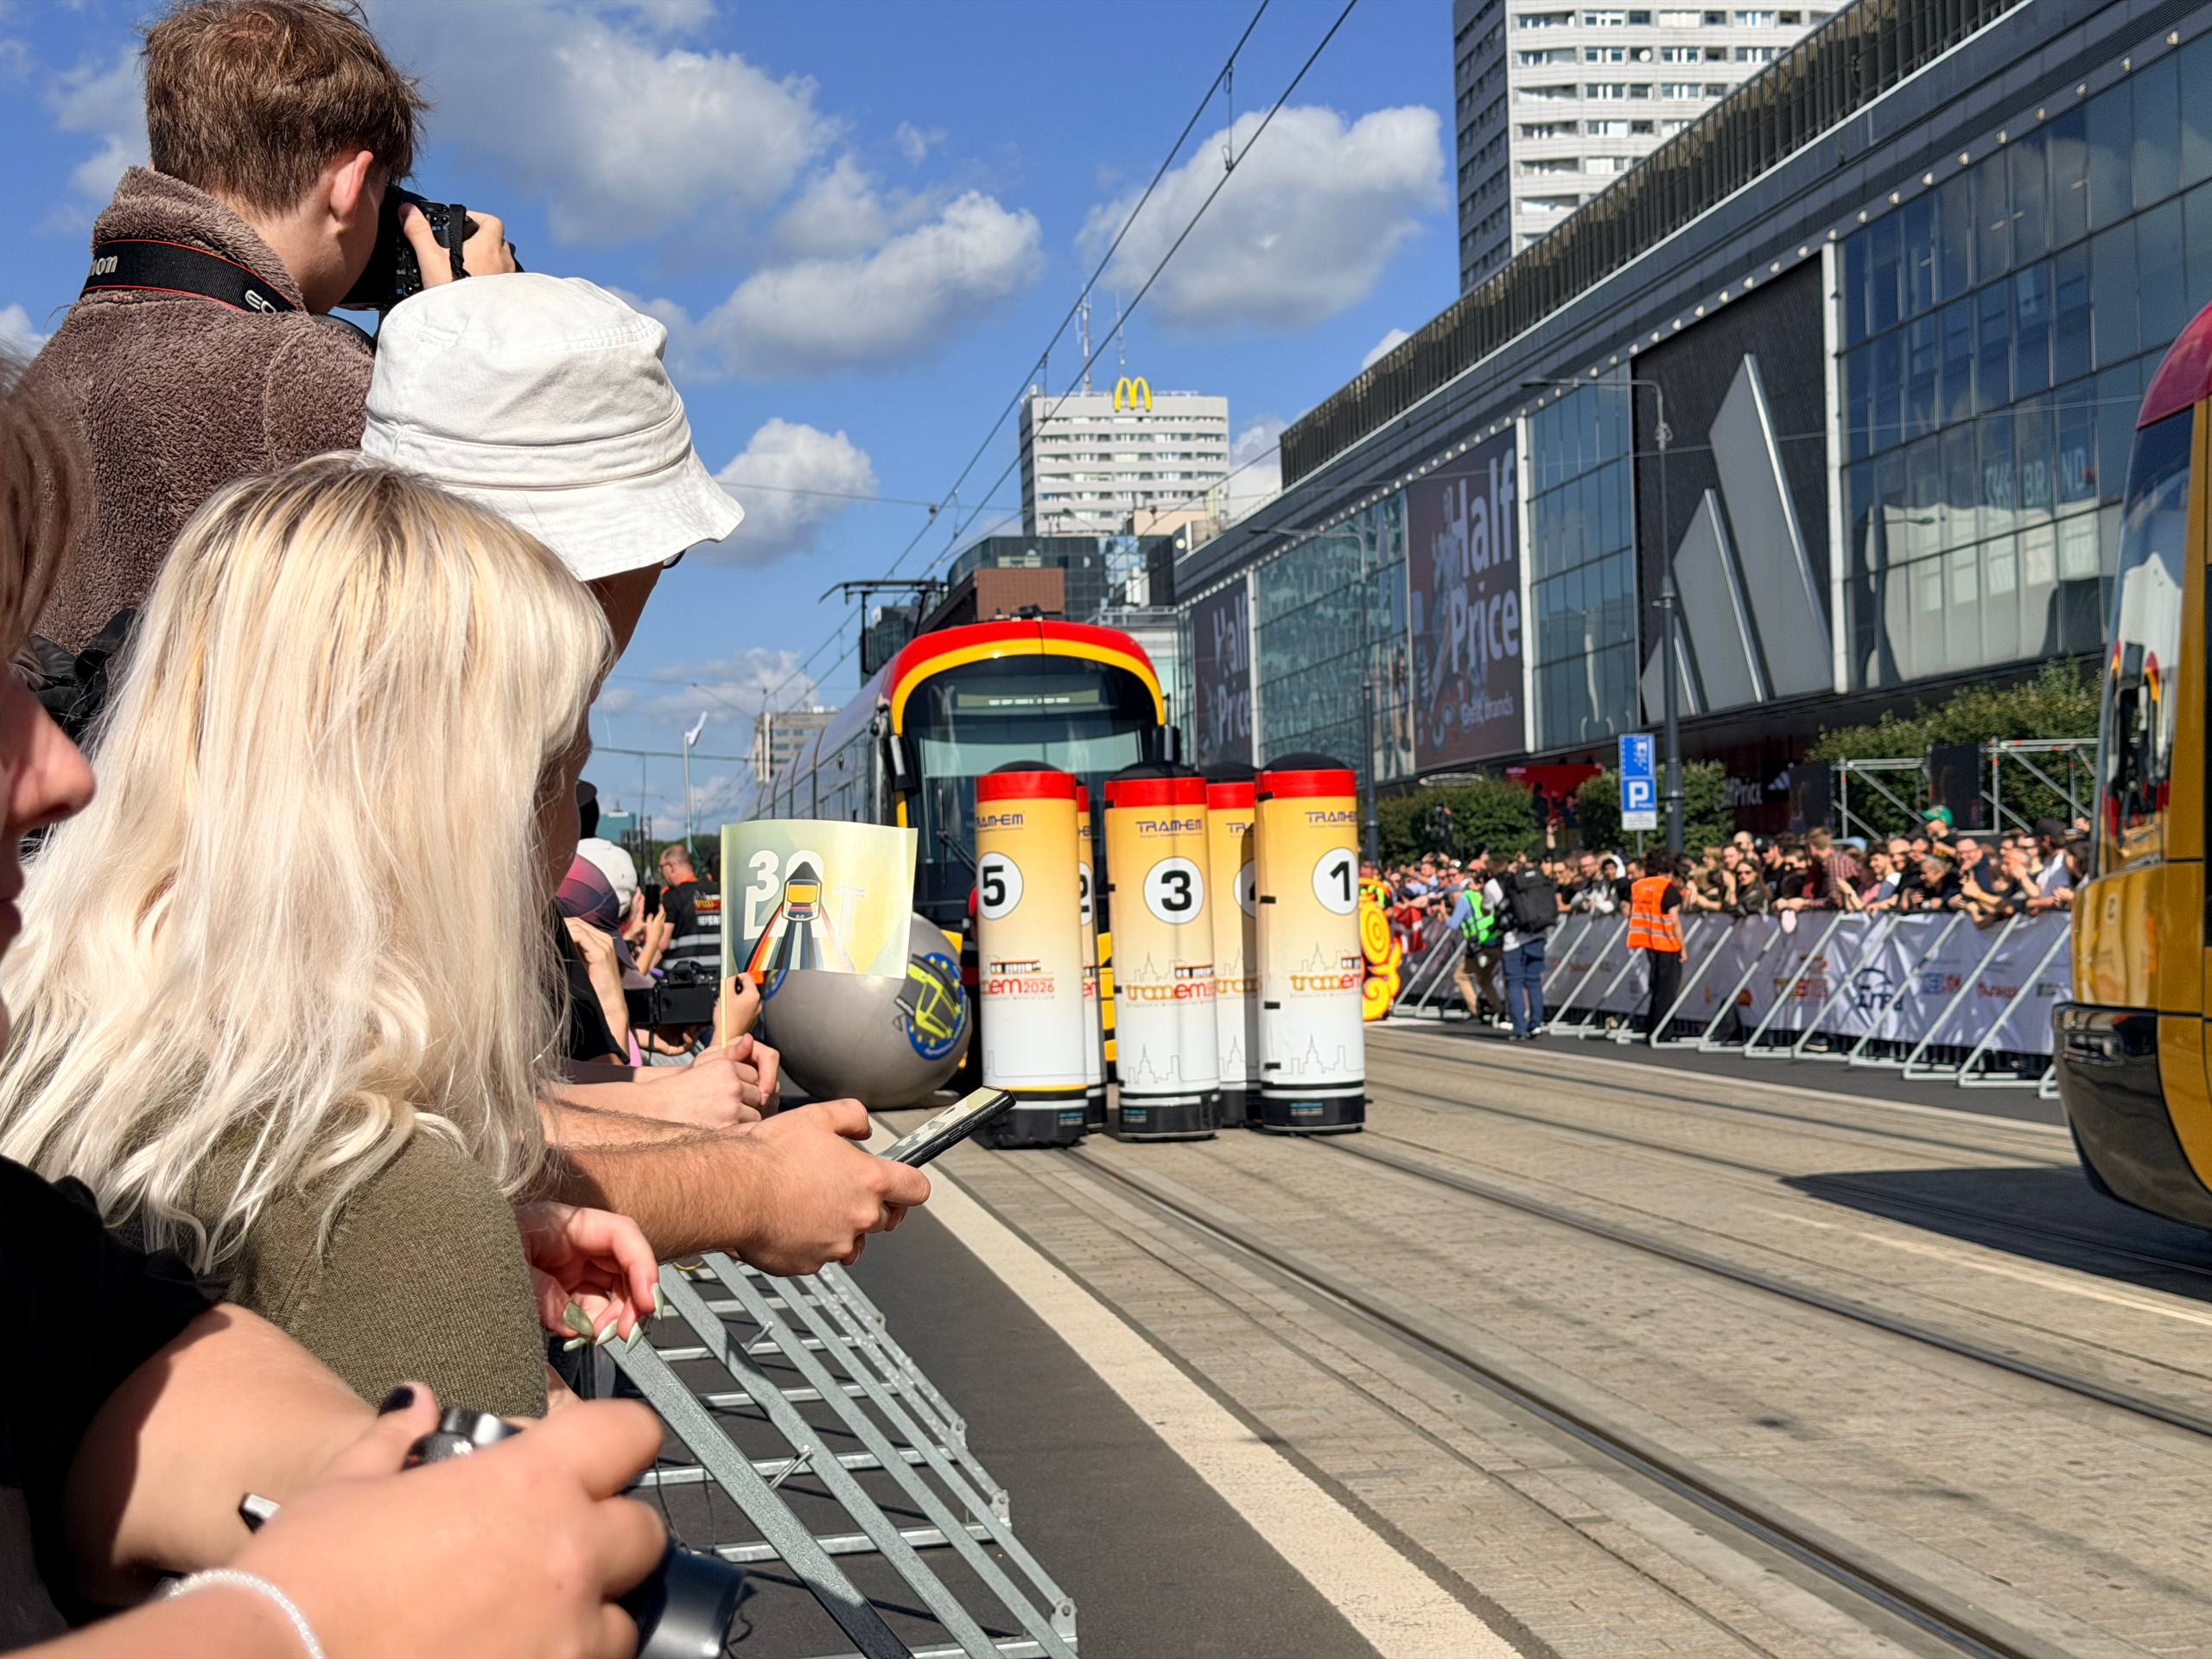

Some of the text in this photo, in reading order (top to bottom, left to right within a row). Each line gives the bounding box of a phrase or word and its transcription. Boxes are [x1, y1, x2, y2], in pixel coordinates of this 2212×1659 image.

[1443, 447, 1516, 578] Half
[1450, 581, 1519, 675] Price
[1628, 781, 1649, 809] P
[982, 865, 1006, 906] 5
[1160, 869, 1192, 912] 3
[1329, 861, 1351, 901] 1
[1023, 980, 1055, 993] 2026
